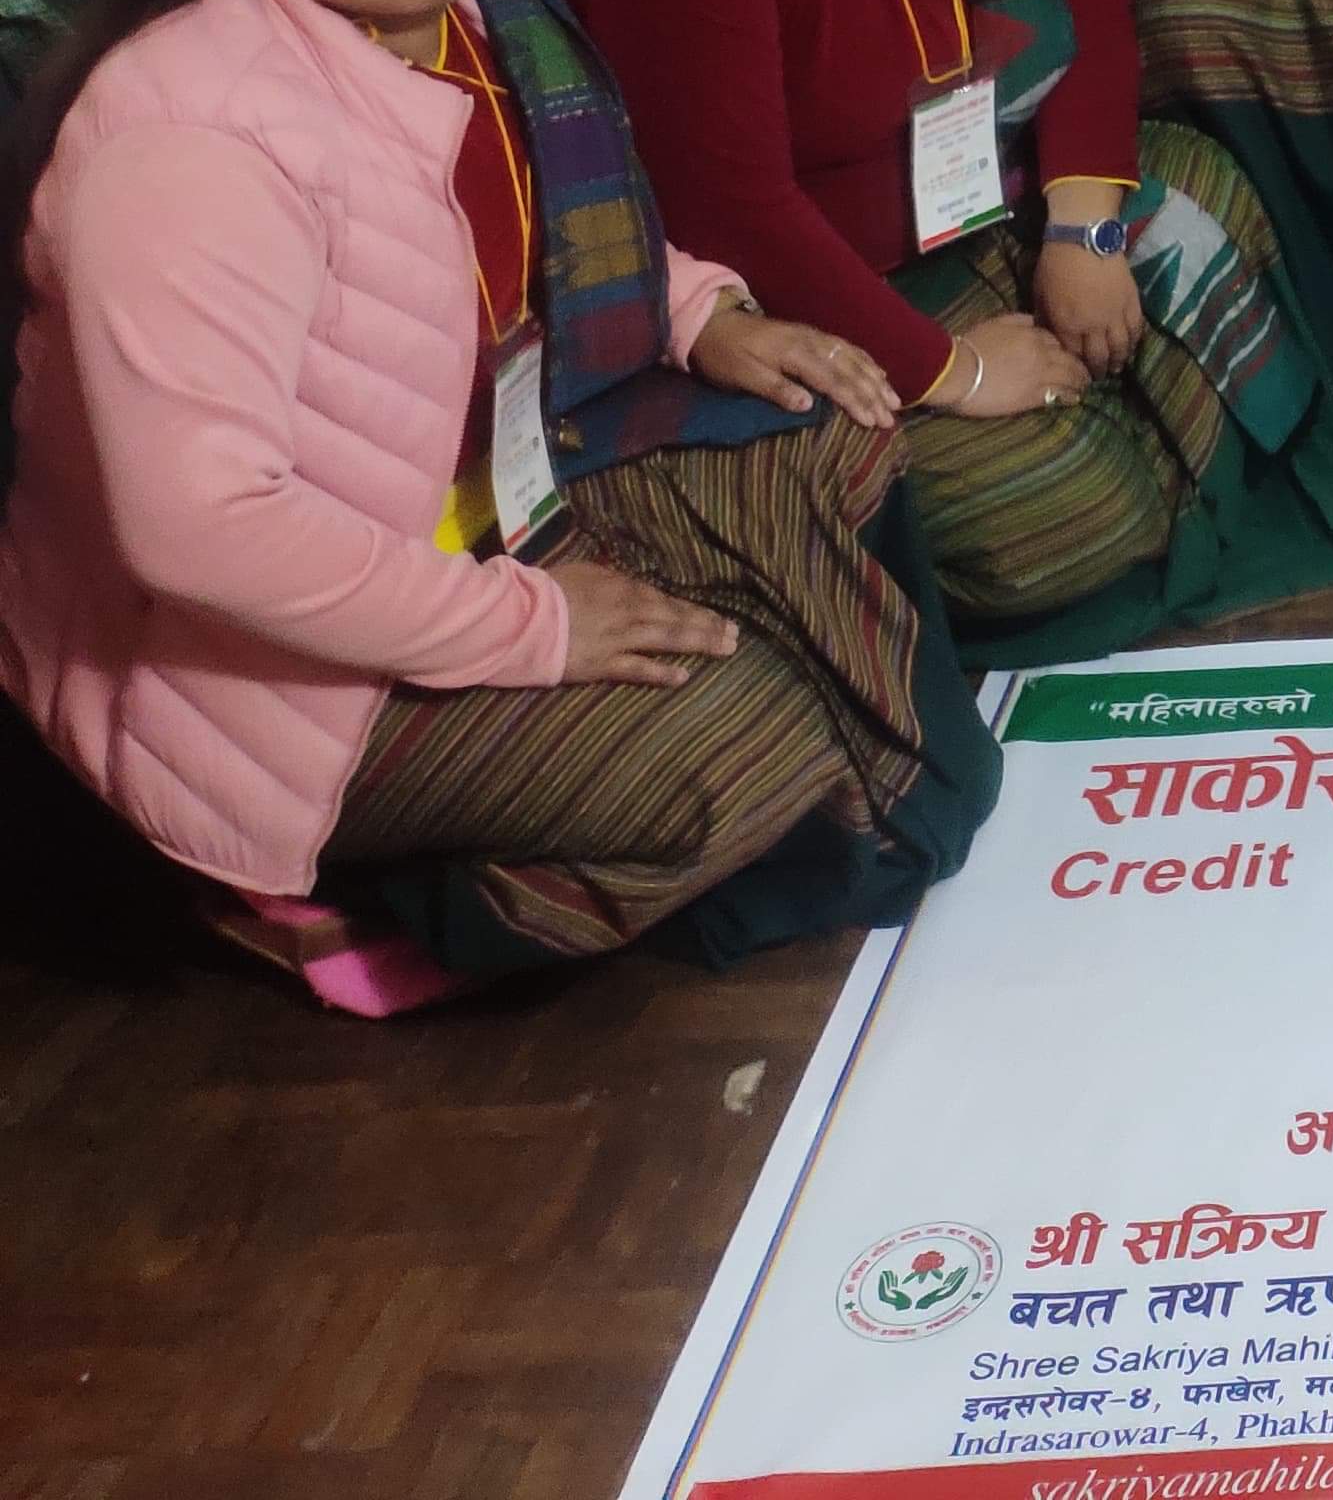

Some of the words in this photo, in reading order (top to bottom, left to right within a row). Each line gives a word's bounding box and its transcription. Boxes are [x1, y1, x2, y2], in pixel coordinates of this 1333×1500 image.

[1051, 843, 1292, 898] Credit
[1025, 1210, 1107, 1269] श्री
[1122, 1202, 1327, 1265] सक्रिय
[1009, 1287, 1129, 1329] बचत
[1148, 1280, 1244, 1324] तथा
[969, 1352, 1080, 1381] Shree
[1092, 1343, 1229, 1376] Sakriya
[1182, 1376, 1285, 1408] फाखेल,
[949, 1416, 1219, 1457] Indrasarowar-4,
